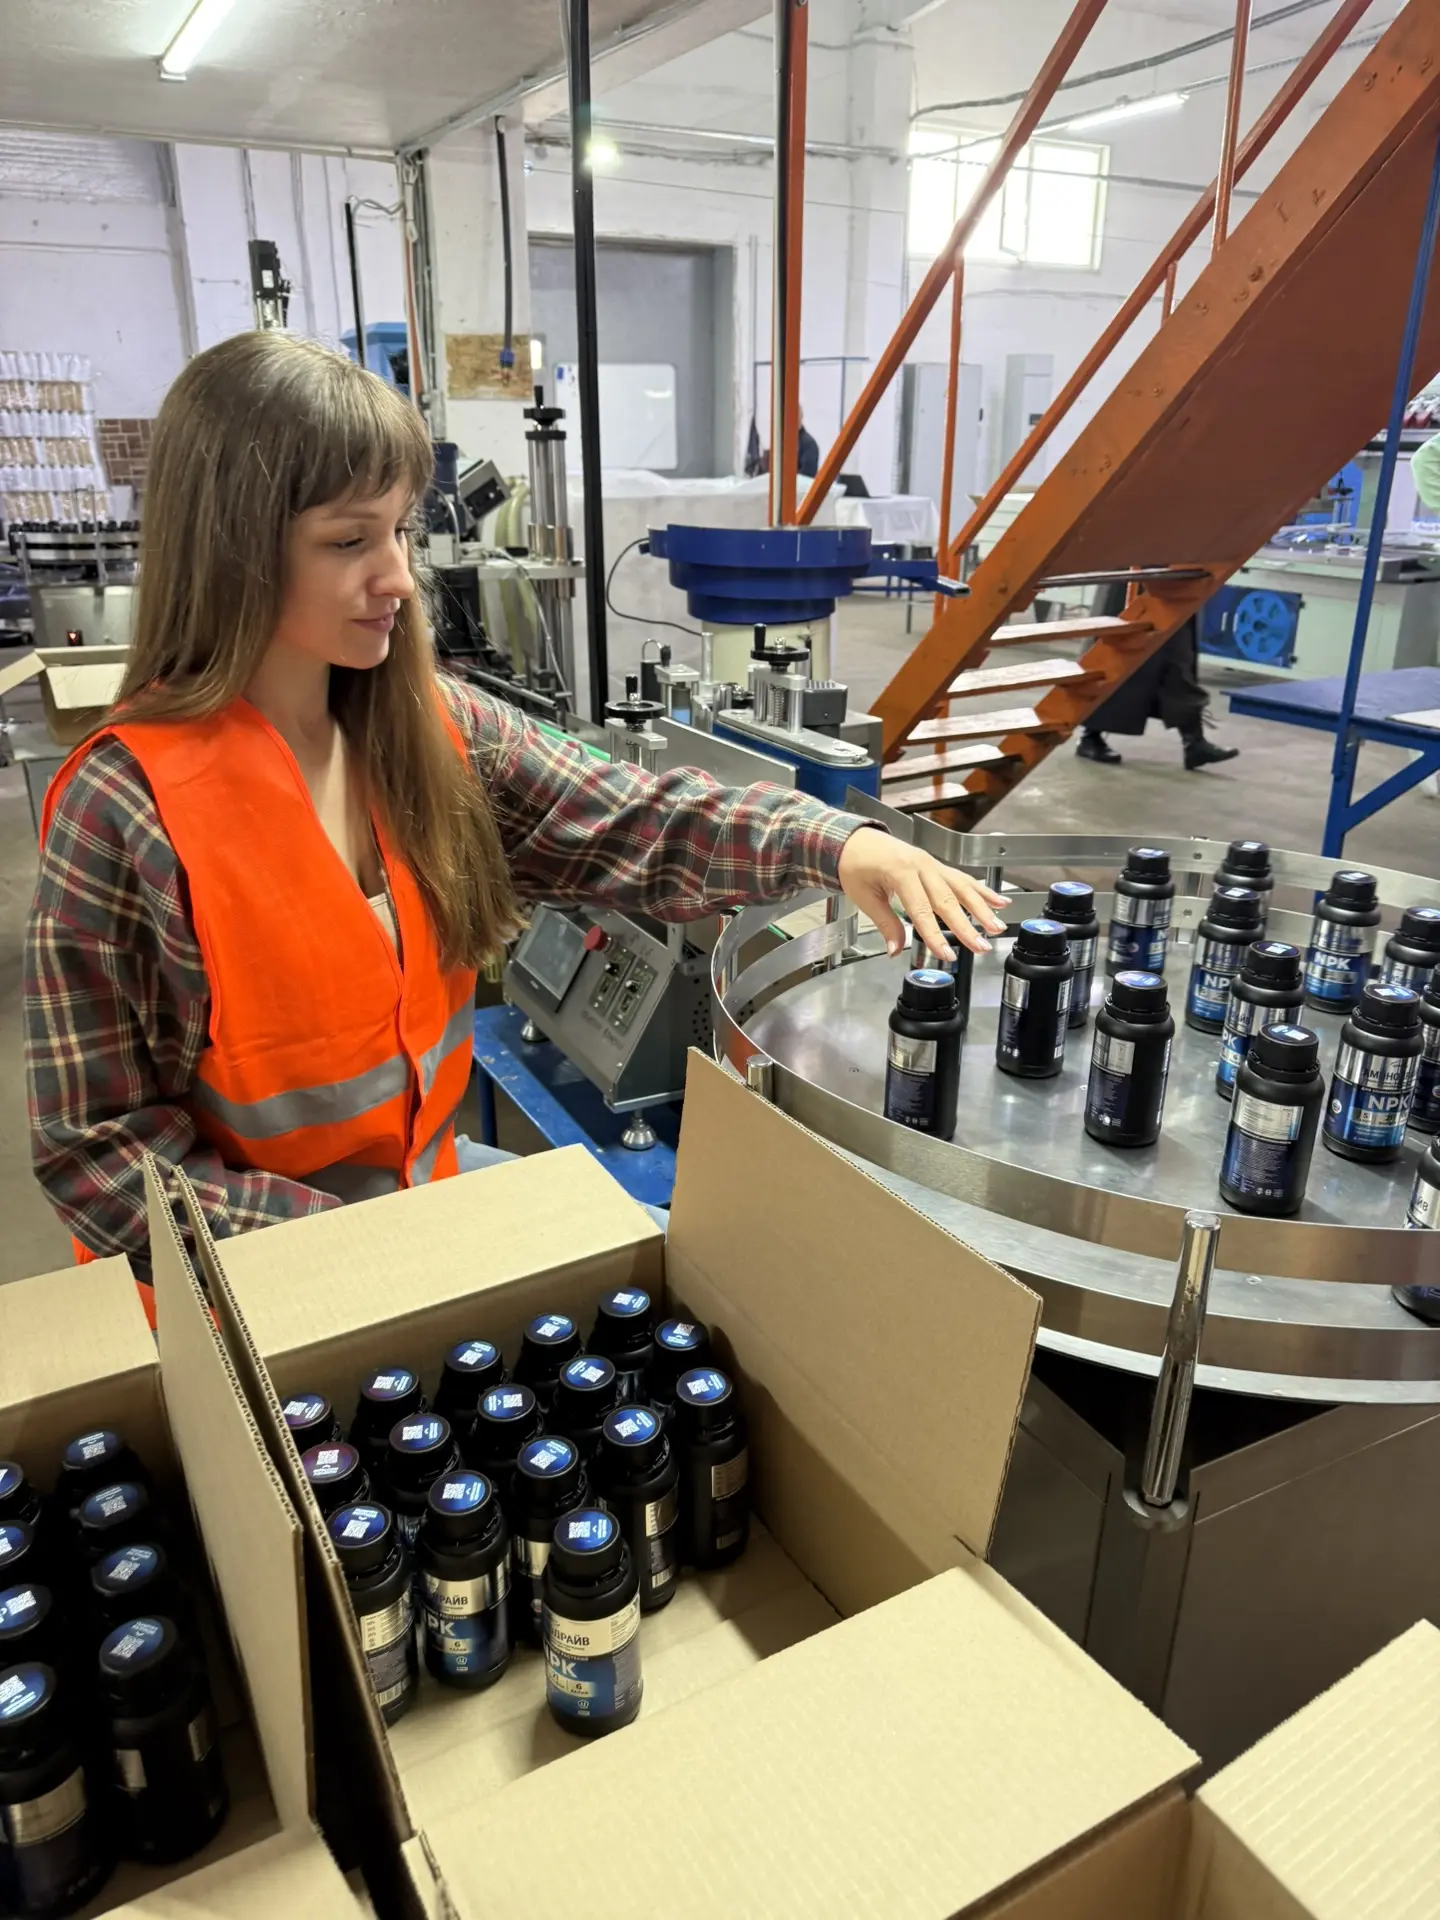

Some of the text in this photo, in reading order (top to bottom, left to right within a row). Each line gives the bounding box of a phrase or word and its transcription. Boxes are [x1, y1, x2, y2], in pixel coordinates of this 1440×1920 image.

[1314, 951, 1352, 970] NPK
[1204, 973, 1231, 989] NP
[1223, 1030, 1238, 1050] PK
[1368, 1095, 1409, 1111] NPK
